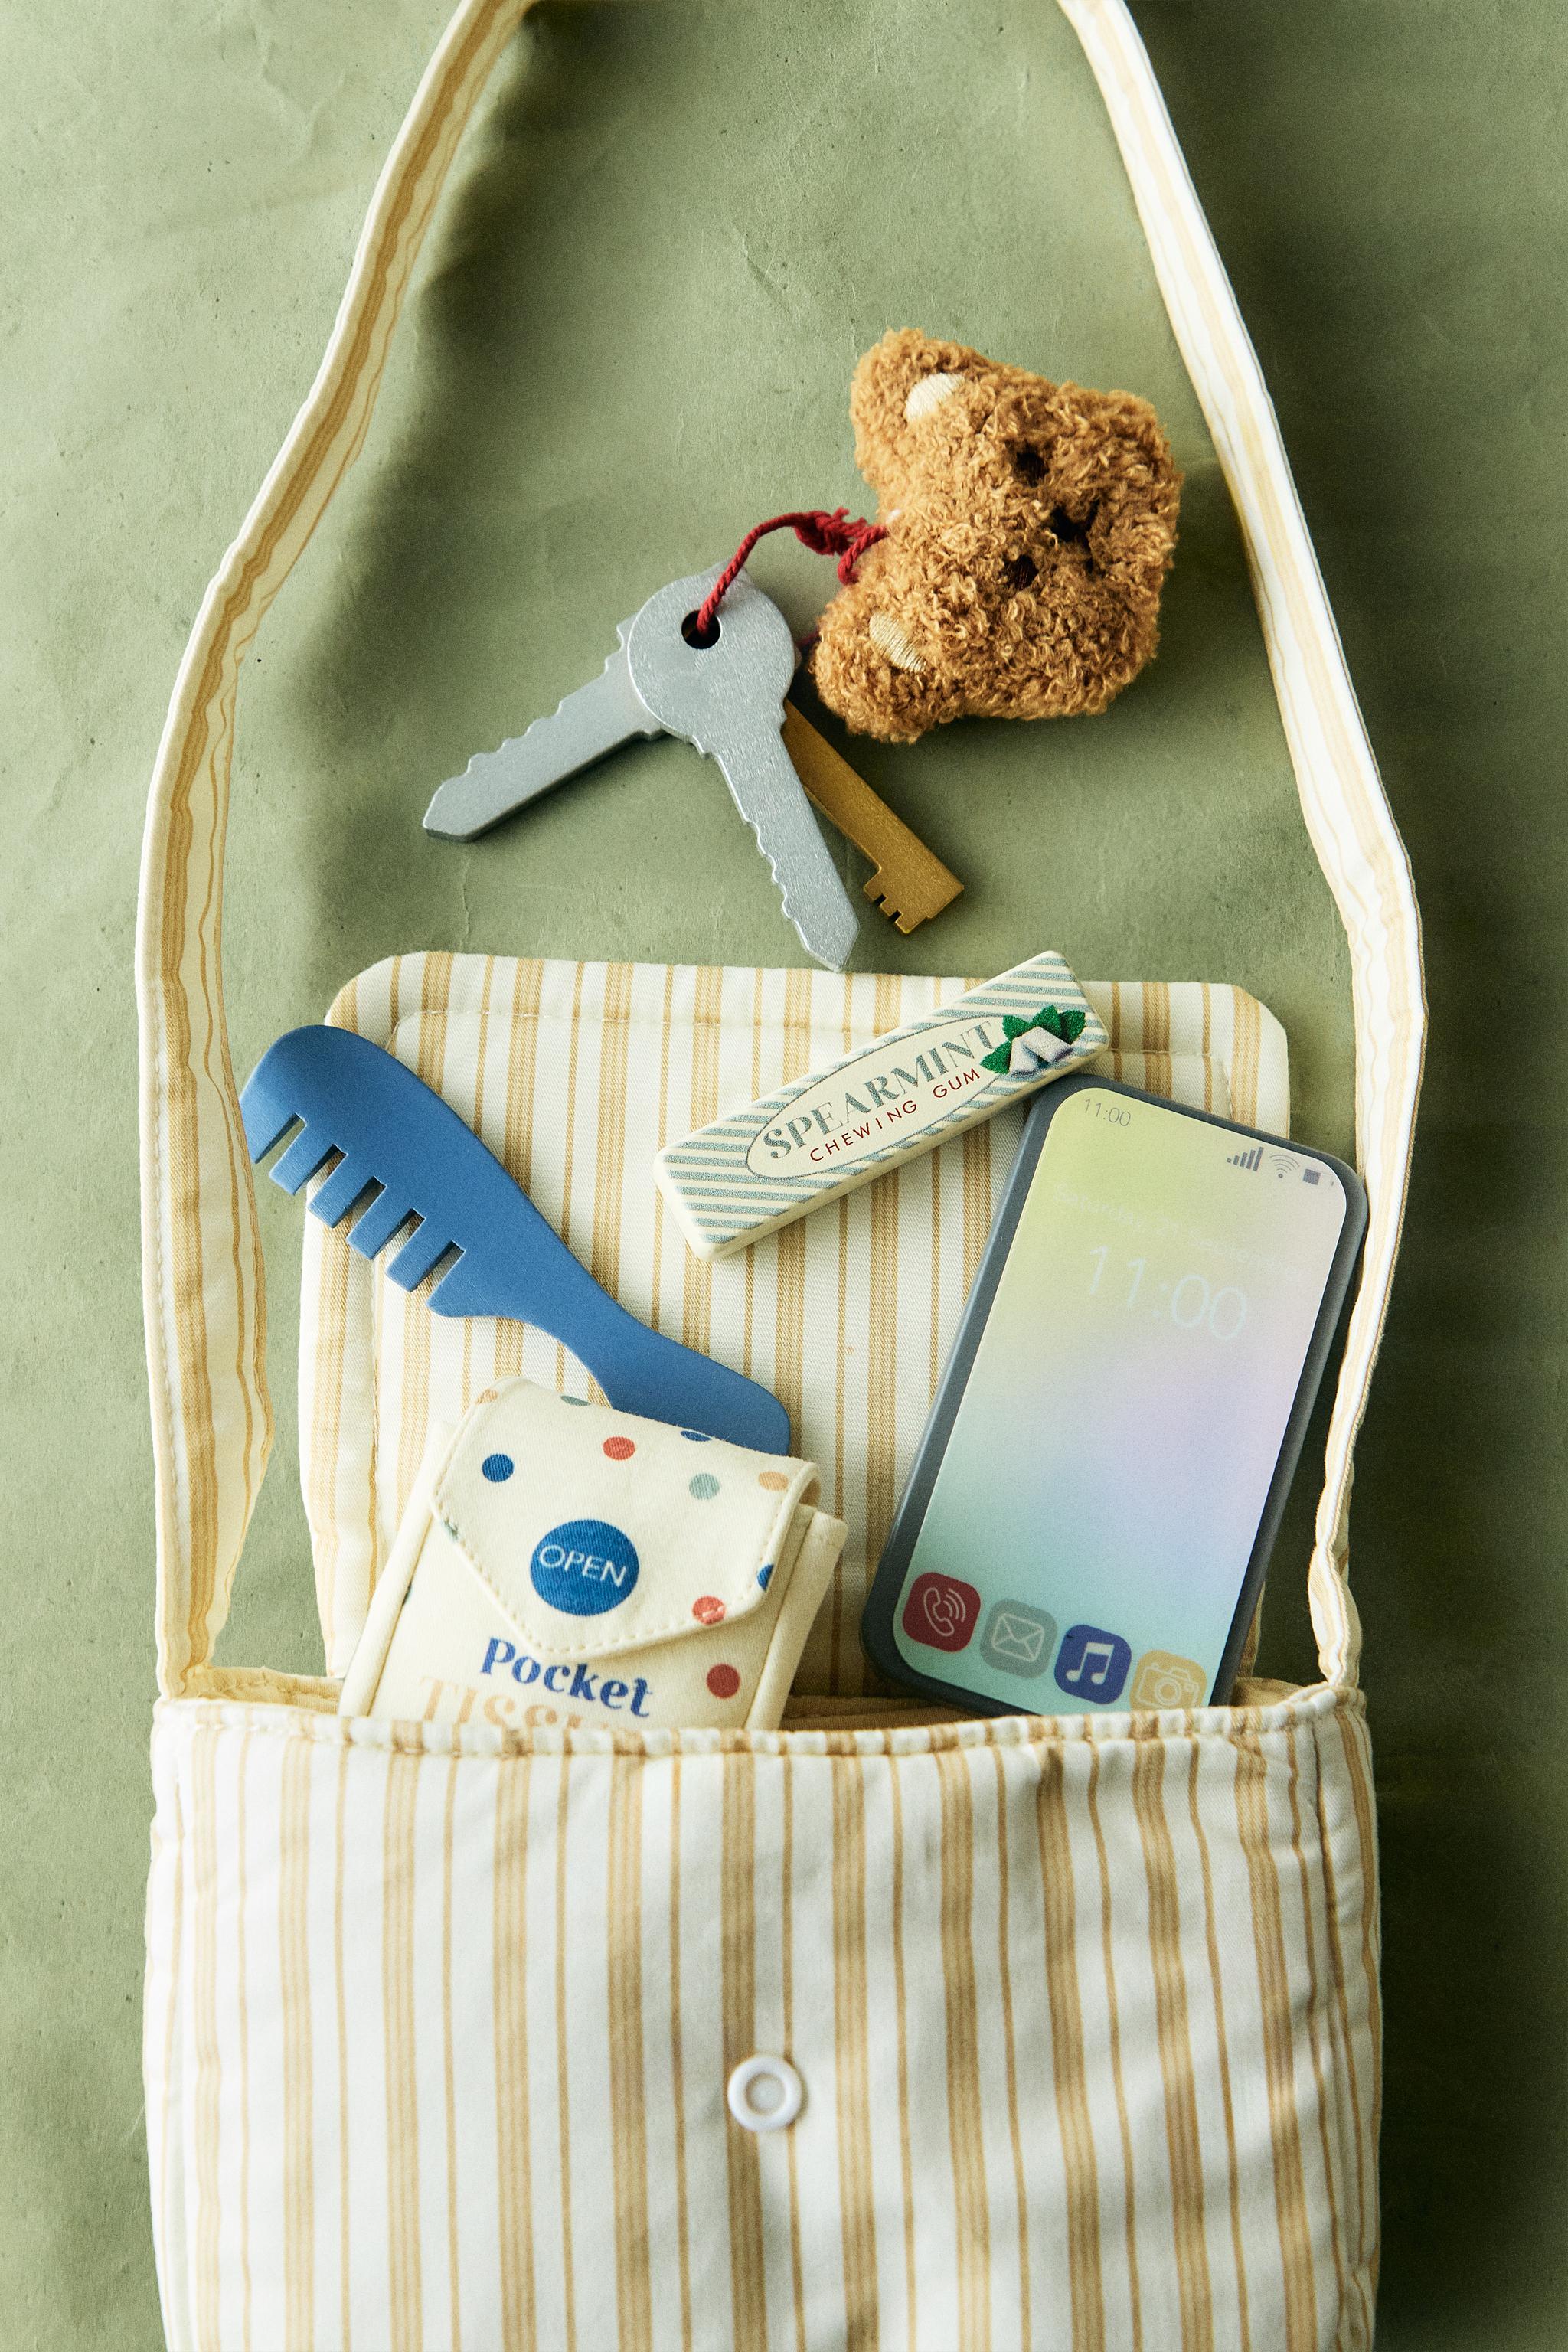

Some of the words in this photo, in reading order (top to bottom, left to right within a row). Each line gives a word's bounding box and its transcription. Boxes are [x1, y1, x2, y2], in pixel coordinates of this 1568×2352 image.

[762, 1020, 1000, 1160] SPEARMINT
[809, 1099, 918, 1162] CHEWING
[933, 1067, 982, 1099] GUM
[1083, 1098, 1132, 1127] 11:00
[1088, 1244, 1248, 1340] 11:00
[537, 1544, 628, 1588] OPEN
[479, 1637, 655, 1718] Pocket
